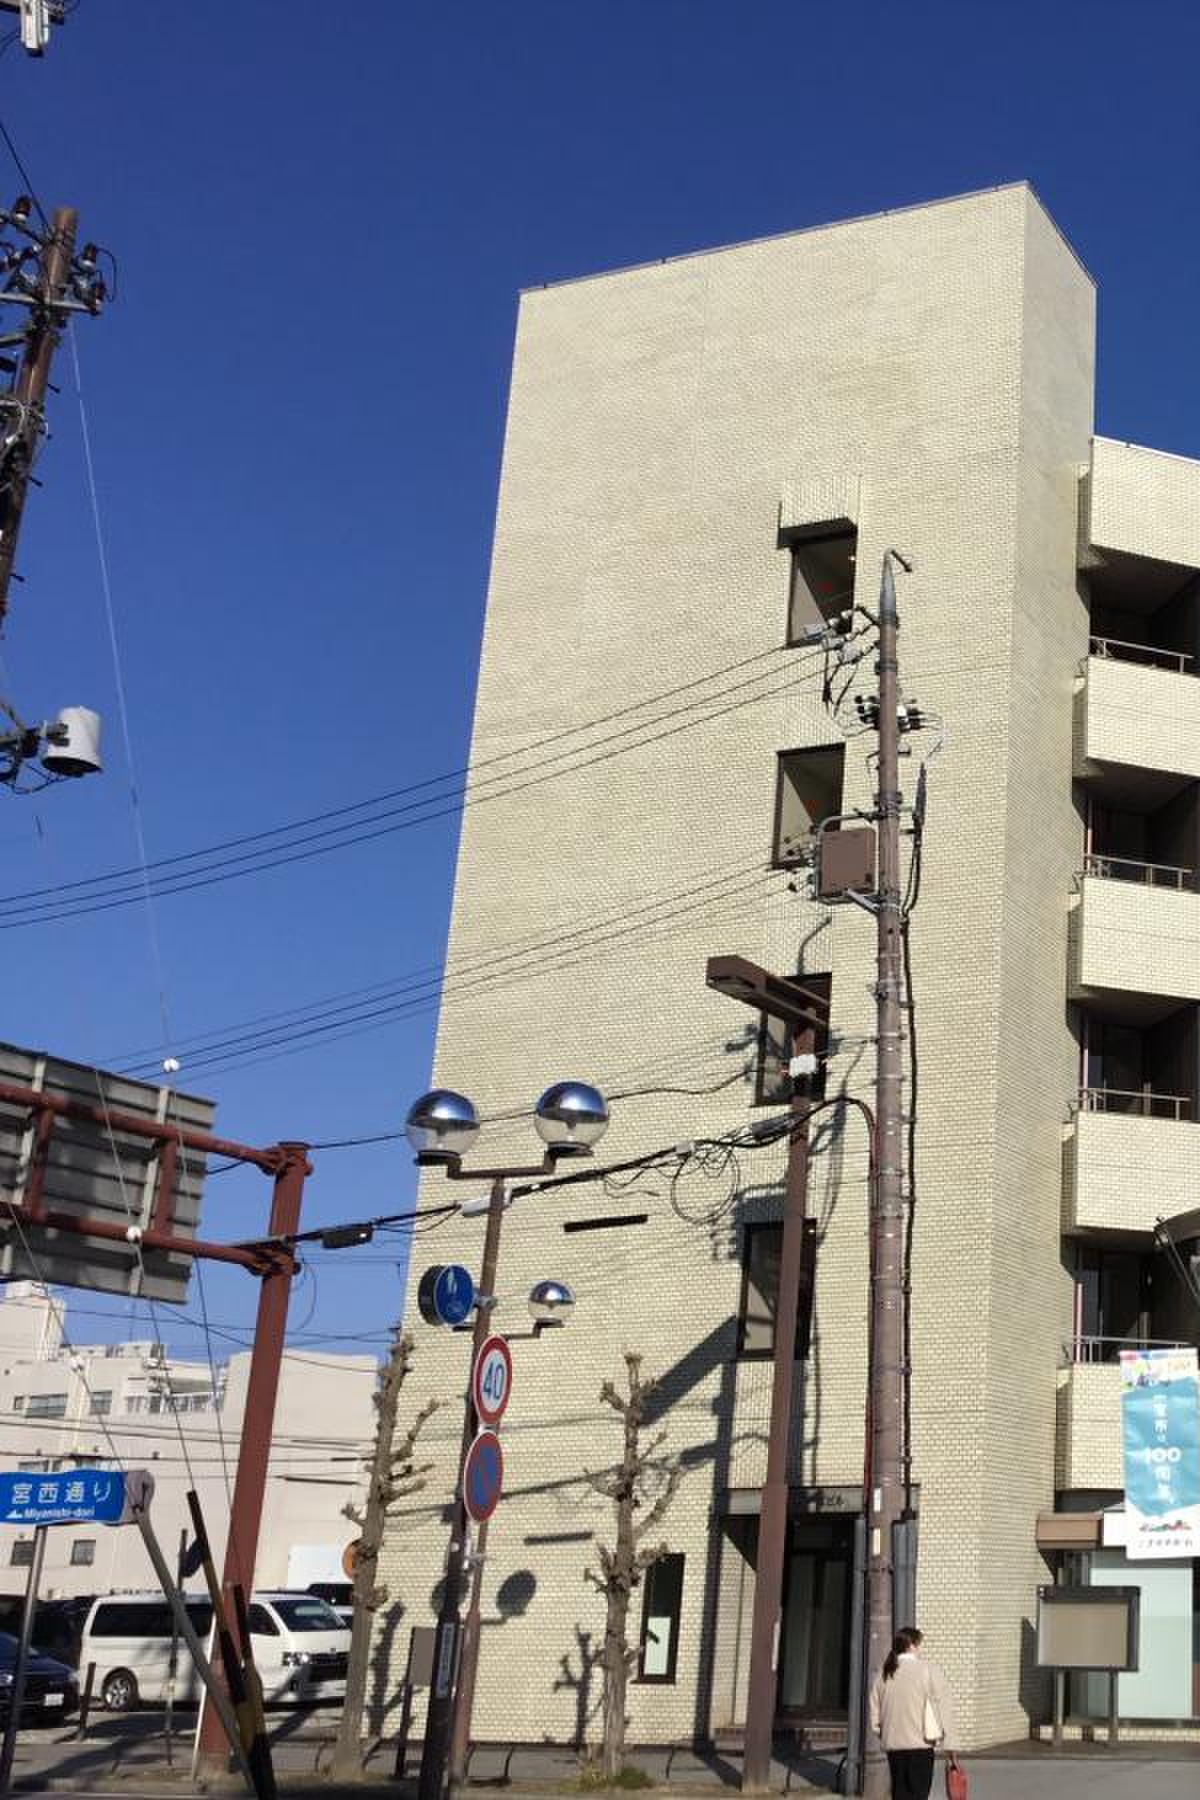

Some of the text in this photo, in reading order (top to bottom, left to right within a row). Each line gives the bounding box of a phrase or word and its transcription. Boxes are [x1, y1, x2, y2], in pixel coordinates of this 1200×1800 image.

[483, 1361, 505, 1400] 40
[11, 1480, 111, 1505] 宮西通り
